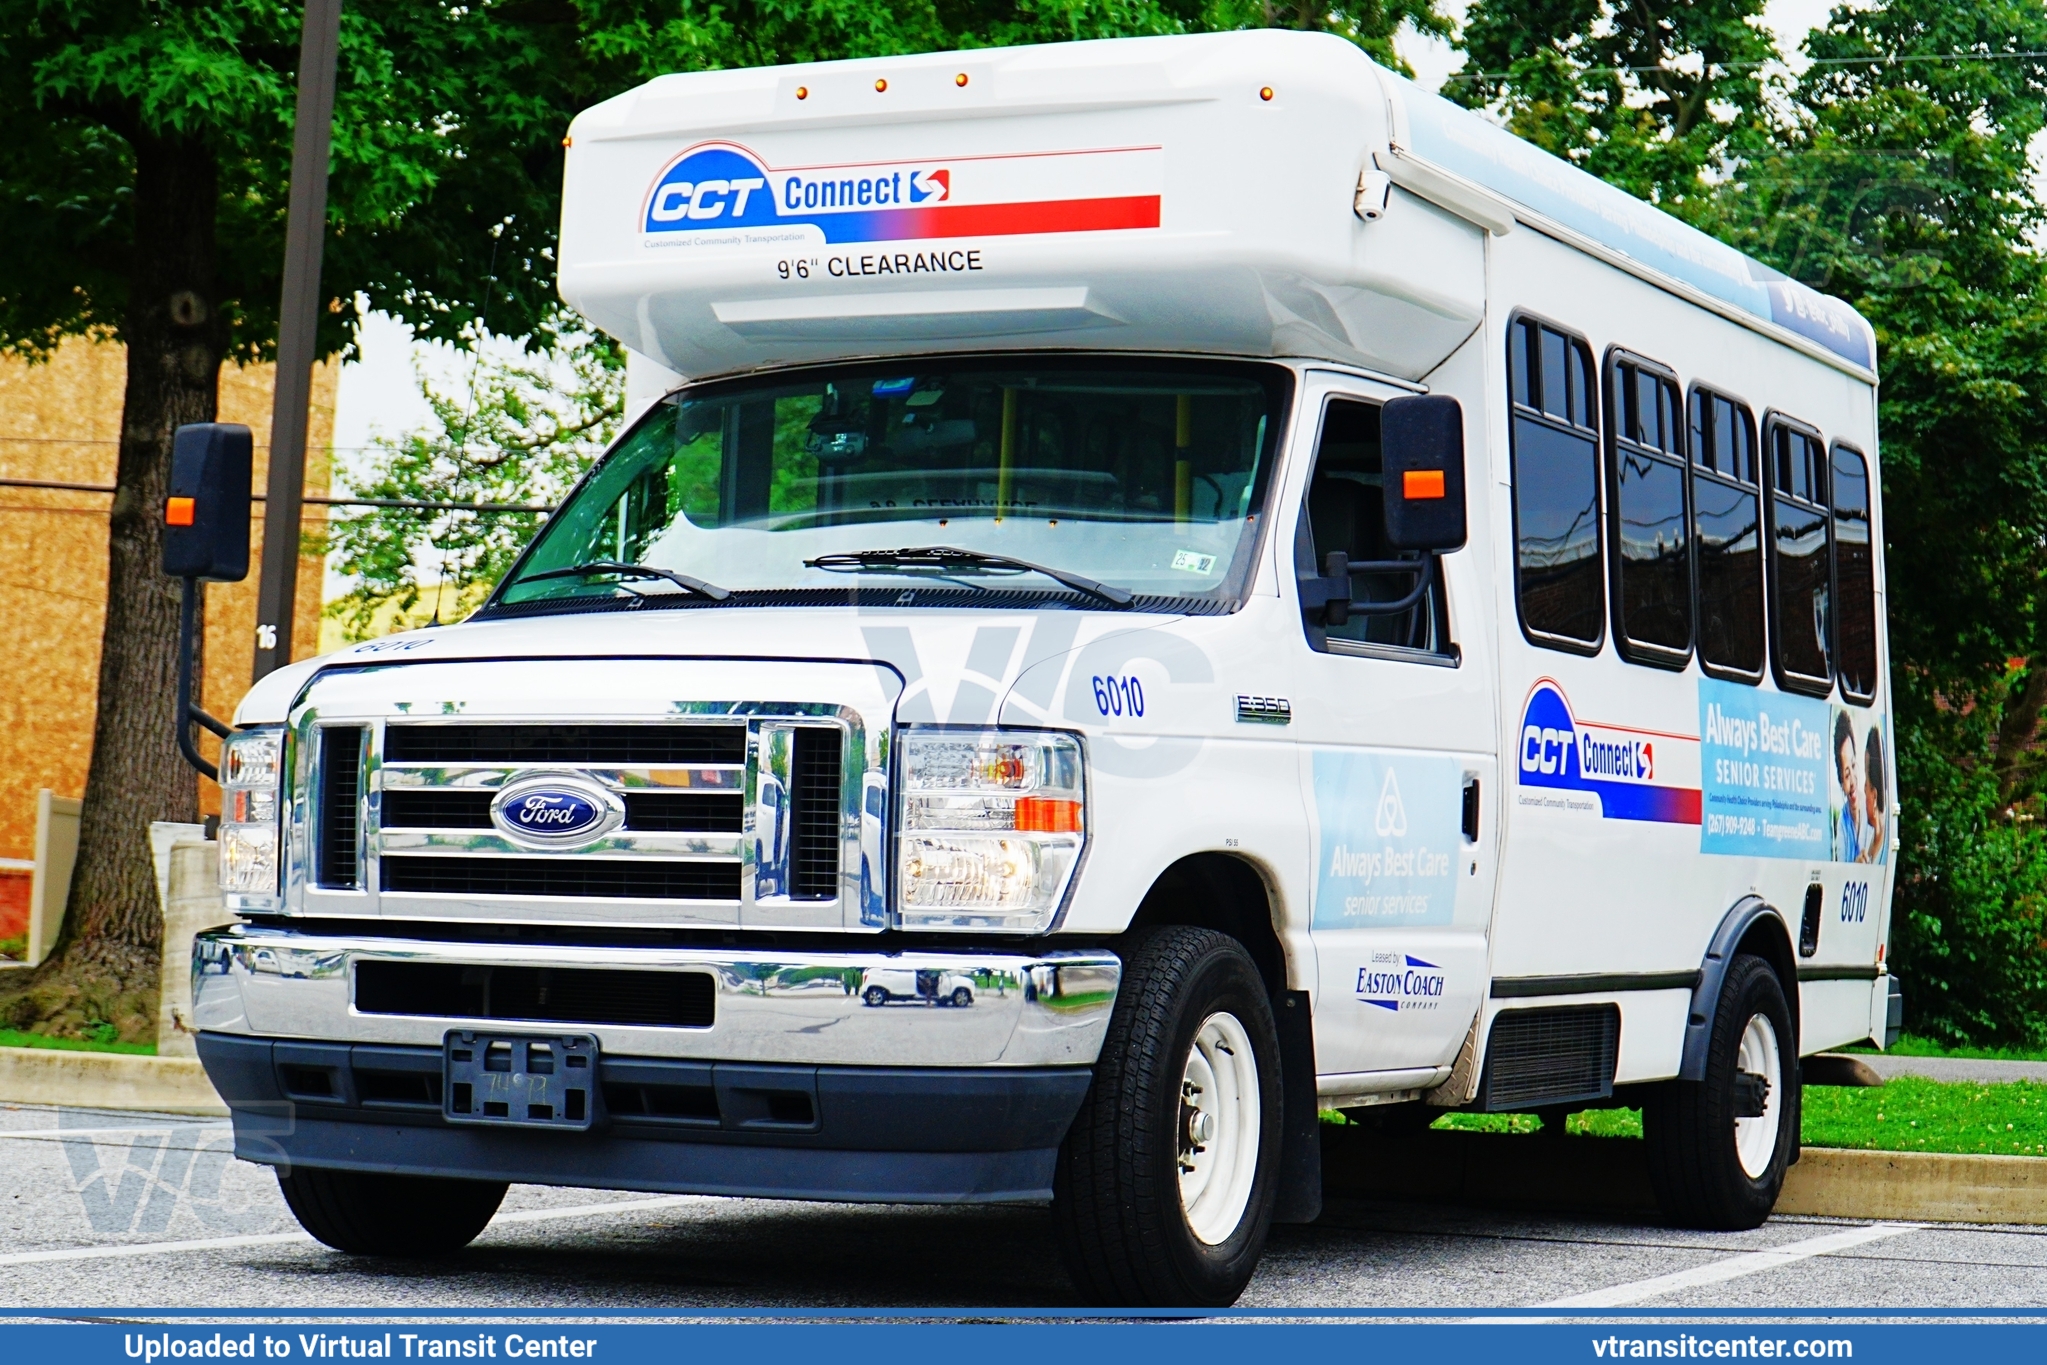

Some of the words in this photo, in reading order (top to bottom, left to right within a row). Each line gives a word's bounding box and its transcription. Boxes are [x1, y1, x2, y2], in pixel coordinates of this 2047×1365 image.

[651, 177, 765, 222] CCT
[785, 172, 901, 209] Connect
[644, 239, 692, 249] Customized
[694, 237, 742, 246] Community
[745, 233, 805, 244] Transportation
[828, 250, 983, 277] CLEARANCE
[256, 624, 277, 650] 16
[355, 639, 435, 653] 6010
[1092, 675, 1144, 717] 6010
[1706, 702, 1757, 757] Always
[1760, 712, 1790, 755] Best
[1792, 718, 1822, 760] Care
[1521, 725, 1574, 775] CCT
[1583, 732, 1633, 777] Connect
[1716, 758, 1760, 787] SENIOR
[1763, 765, 1815, 794] SERVICES
[520, 795, 576, 823] Ford
[1708, 813, 1725, 836] (267)
[1330, 844, 1381, 886] Always
[1385, 846, 1414, 876] Best
[1417, 846, 1449, 876] Care
[1343, 891, 1381, 916] senior
[1382, 890, 1429, 914] services
[1841, 880, 1868, 922] 6010
[1371, 950, 1392, 963] Leased
[1400, 1001, 1438, 1010] COMPANY
